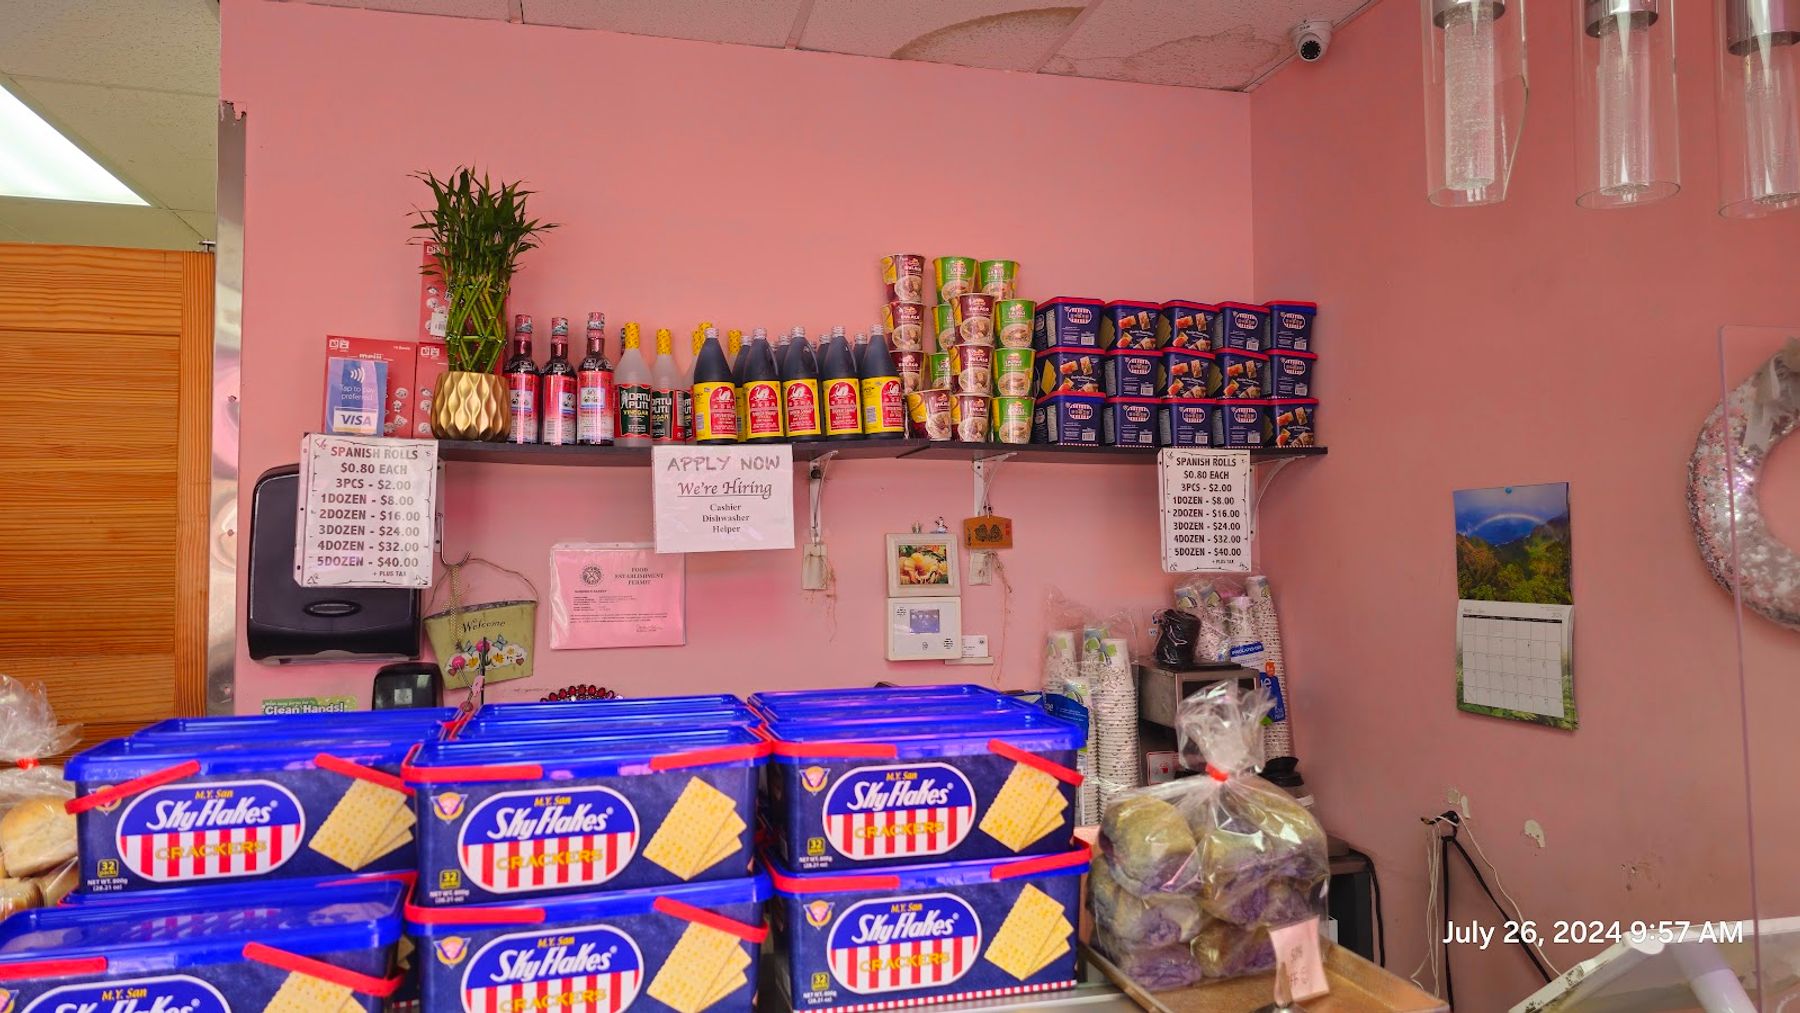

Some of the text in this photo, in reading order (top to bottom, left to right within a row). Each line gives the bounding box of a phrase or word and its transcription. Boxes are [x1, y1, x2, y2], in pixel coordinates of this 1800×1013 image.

[341, 415, 372, 425] VISA
[331, 447, 418, 460] SPANISH ROLLS
[667, 456, 780, 471] APPLY NOW
[1177, 457, 1236, 467] SPANISH ROLLS
[341, 463, 407, 475] $0.80 EACH
[1184, 471, 1229, 479] $0.80 EACH
[336, 478, 364, 489] 3PCS
[378, 480, 411, 490] $2.00
[677, 477, 772, 500] We're Hiring
[1181, 483, 1200, 491] 3PCS
[1209, 484, 1232, 492] $2.00
[321, 494, 367, 504] 1DOZEN
[380, 495, 414, 505] $8.00
[1212, 497, 1234, 505] $8.00
[320, 509, 366, 520] 2DOZEN
[380, 510, 420, 521] $16.00
[702, 514, 749, 522] Dishwasher
[1172, 509, 1203, 517] 2DOZEN
[1212, 509, 1240, 517] $16.00
[319, 525, 365, 535] 3DOZEN
[379, 526, 420, 536] $24.00
[712, 525, 741, 534] Helper
[1174, 522, 1204, 530] 3DOZEN
[1213, 522, 1240, 531] $24.00
[1174, 535, 1205, 543] 4DOZEN
[1213, 535, 1241, 543] $32.00
[317, 540, 364, 551] 4DOZEN
[378, 541, 419, 552] $32.00
[1174, 547, 1205, 556] 5DOZEN
[1214, 548, 1241, 556] $40.00
[317, 556, 363, 567] 5DOZEN
[378, 557, 418, 568] $40.00
[462, 620, 506, 633] Welcome
[265, 702, 344, 715] Clean Hands!
[195, 789, 233, 799] M.Y. San
[554, 796, 572, 805] San
[855, 821, 945, 838] CRACKERS
[155, 840, 268, 860] CRACKERS
[496, 849, 604, 870] CRACKERS
[101, 861, 115, 871] 32
[443, 871, 457, 882] 32
[557, 936, 575, 947] San
[860, 952, 950, 972] CRACKERS
[814, 974, 827, 984] 32
[101, 988, 147, 1001] M.Y. San
[501, 988, 607, 1013] CRACKERS
